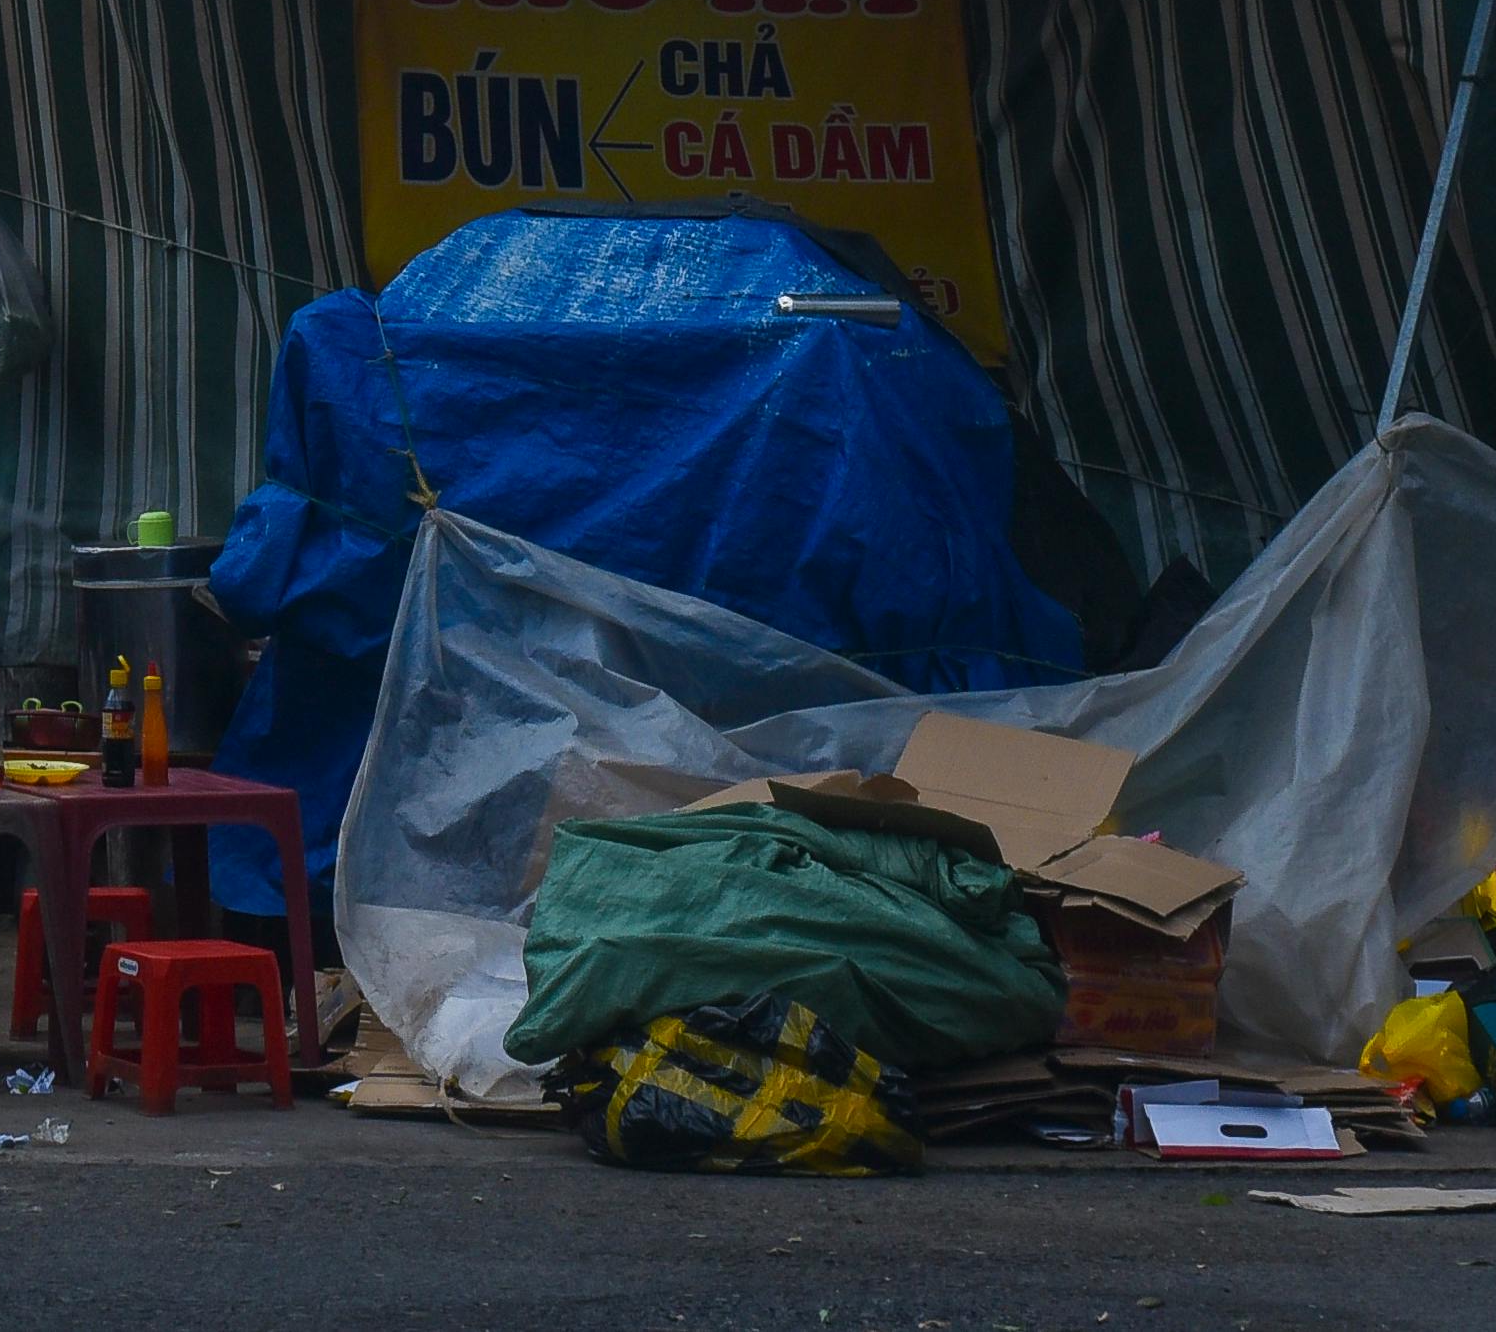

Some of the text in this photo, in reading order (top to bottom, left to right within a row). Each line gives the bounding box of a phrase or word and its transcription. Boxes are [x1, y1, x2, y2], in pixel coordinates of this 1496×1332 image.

[658, 22, 794, 100] CHẢ
[398, 47, 587, 190] BÚN
[662, 108, 754, 181] CÁ
